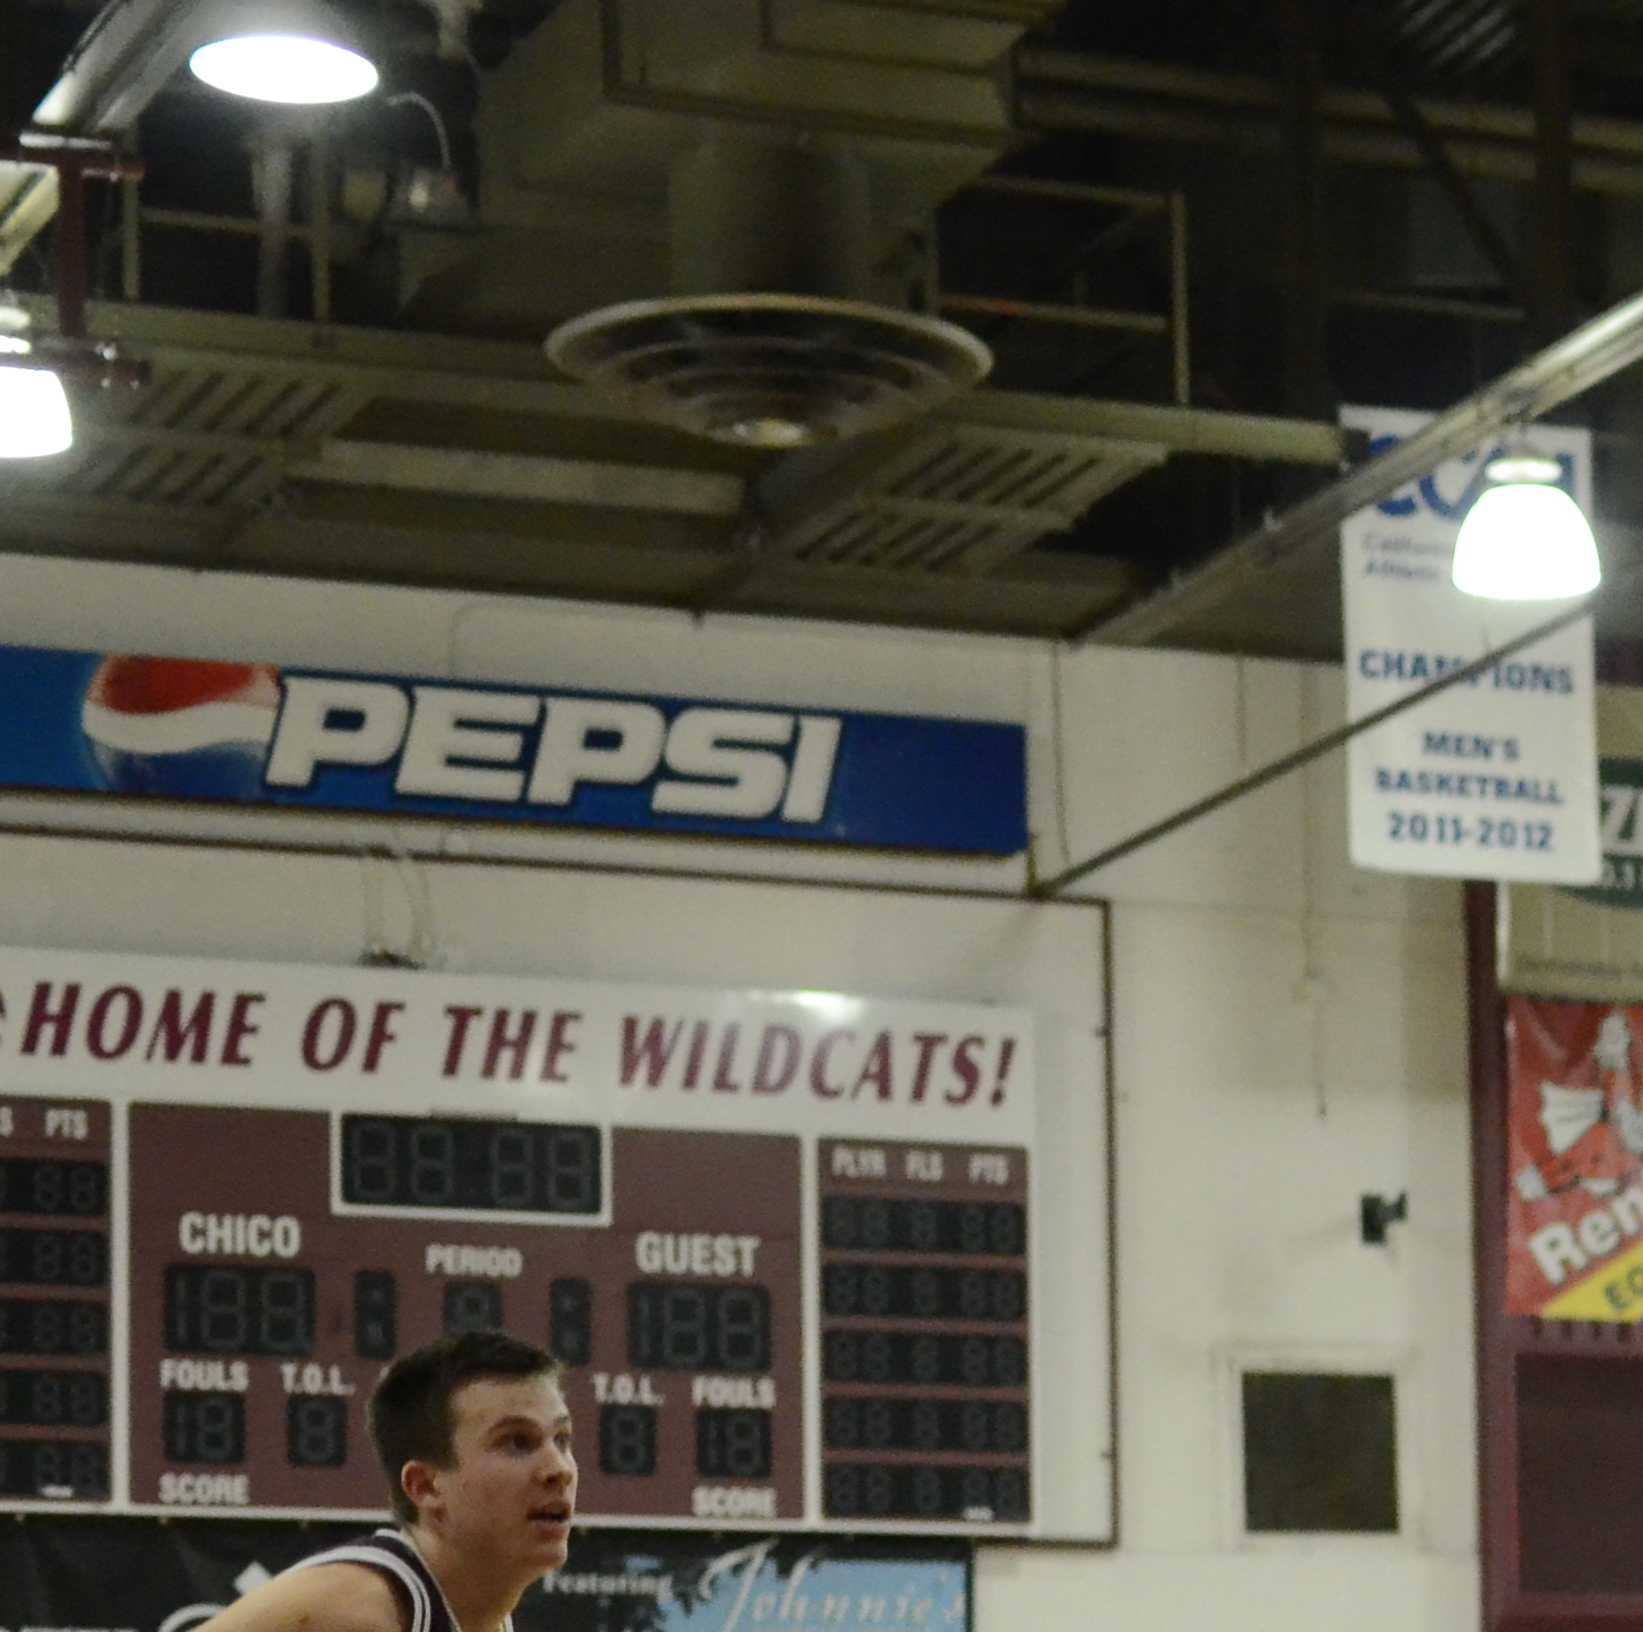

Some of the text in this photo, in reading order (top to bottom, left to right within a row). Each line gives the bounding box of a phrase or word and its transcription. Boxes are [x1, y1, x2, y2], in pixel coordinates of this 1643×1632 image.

[1359, 648, 1575, 695] CHAMIONS
[266, 674, 842, 825] PEPSI
[1423, 729, 1521, 762] MEN'S
[1375, 767, 1564, 807] BASKETBALL
[1387, 810, 1555, 852] 2011-2012
[20, 981, 1019, 1107] HOME OF THE WILDCATS!
[44, 1109, 88, 1140] PTS
[178, 1211, 302, 1258] CHICO
[425, 1244, 524, 1278] PERIOD
[635, 1231, 761, 1278] GUEST
[160, 1359, 250, 1393] FOULS
[282, 1363, 355, 1395] T.O.L.
[592, 1373, 663, 1406] T.O.L.
[693, 1374, 776, 1409] FOULS
[159, 1474, 251, 1505] SCORE
[692, 1487, 777, 1519] SCORE
